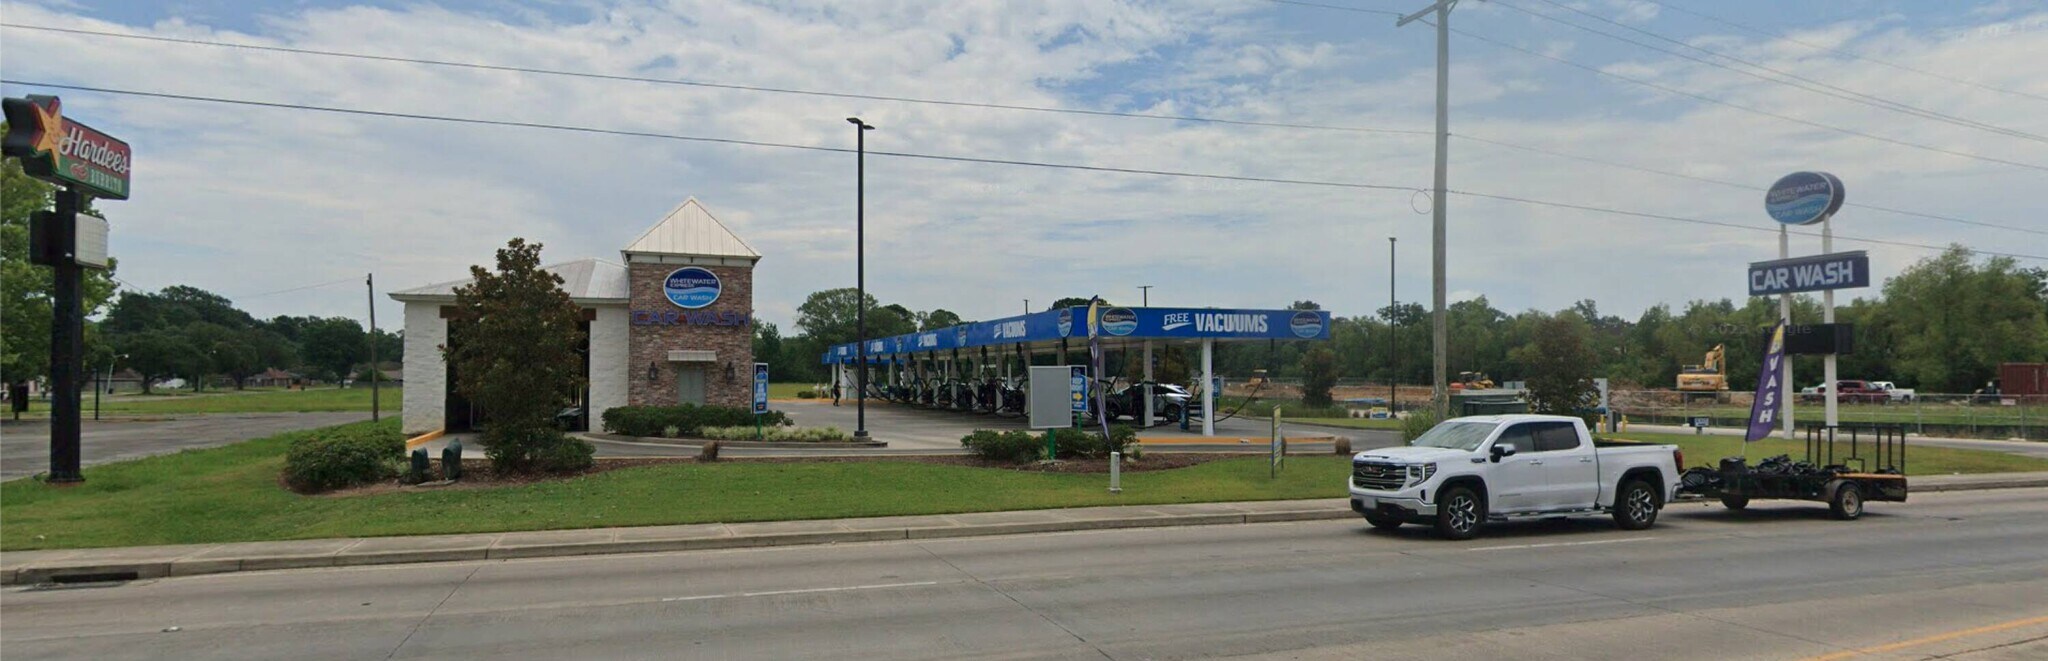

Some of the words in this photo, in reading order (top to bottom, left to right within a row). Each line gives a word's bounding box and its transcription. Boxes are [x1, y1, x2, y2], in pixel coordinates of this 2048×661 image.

[59, 127, 130, 174] Hardee's
[1769, 182, 1827, 198] WHITEWATER
[1751, 267, 1790, 291] CAR
[1793, 260, 1854, 288] WASH
[631, 310, 680, 326] CAR
[685, 310, 751, 327] WASH
[1164, 312, 1190, 326] FREE
